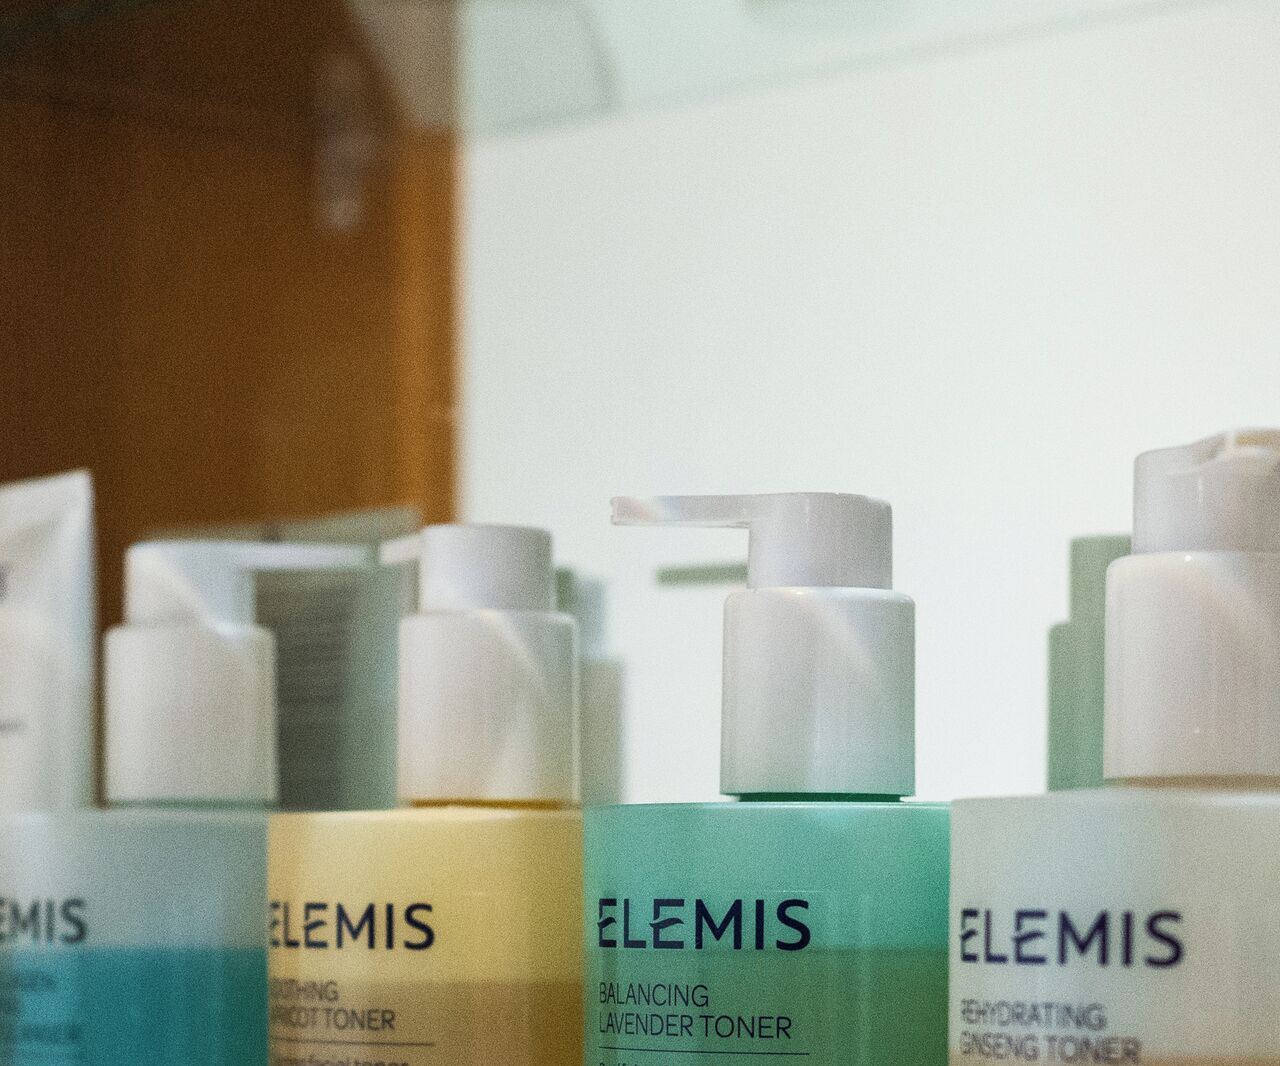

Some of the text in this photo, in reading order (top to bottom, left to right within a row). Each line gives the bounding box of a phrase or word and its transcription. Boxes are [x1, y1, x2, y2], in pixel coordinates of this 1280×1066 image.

[597, 898, 811, 951] ELEMIS
[959, 908, 1185, 968] ELEMIS
[600, 982, 709, 1008] BALANCING
[324, 1006, 396, 1031] TONER
[600, 1012, 793, 1040] LAVENDER TONER
[1043, 1034, 1143, 1066] TONER
